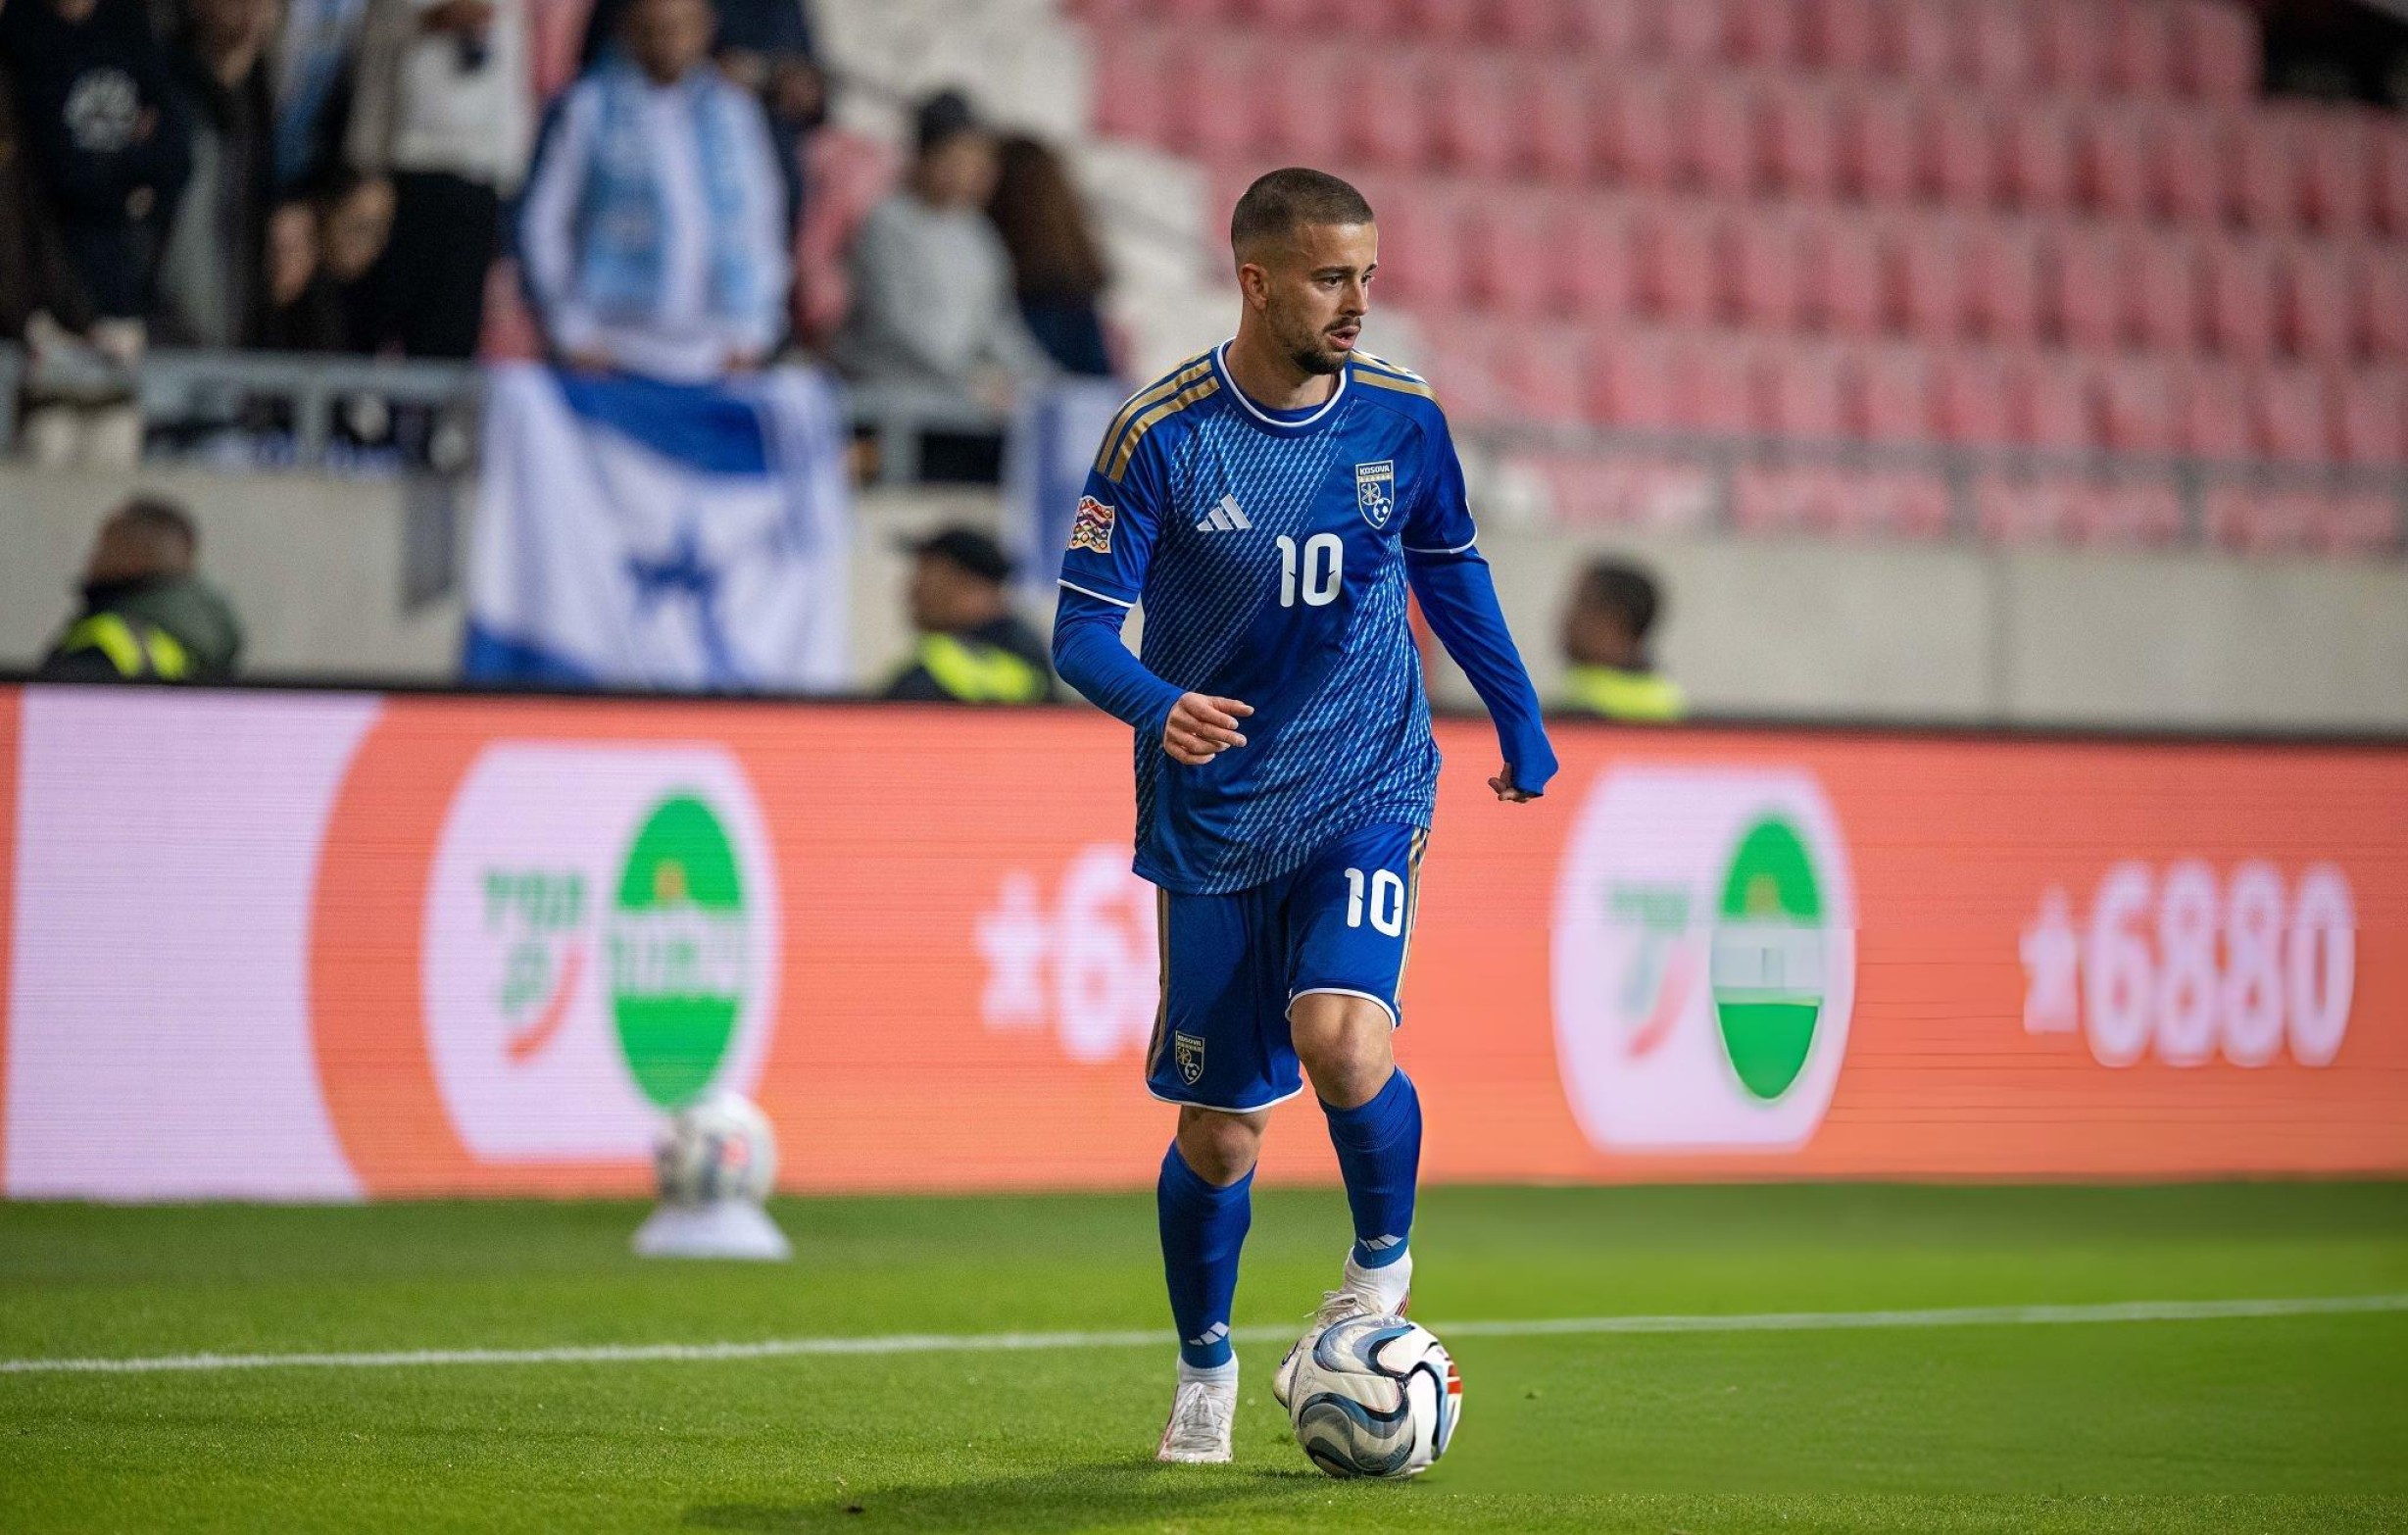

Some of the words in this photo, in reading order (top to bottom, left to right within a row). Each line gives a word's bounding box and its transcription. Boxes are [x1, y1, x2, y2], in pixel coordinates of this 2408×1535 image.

[1359, 465, 1390, 476] KOSOVA
[1277, 533, 1344, 608] 10
[1344, 867, 1405, 937] 10
